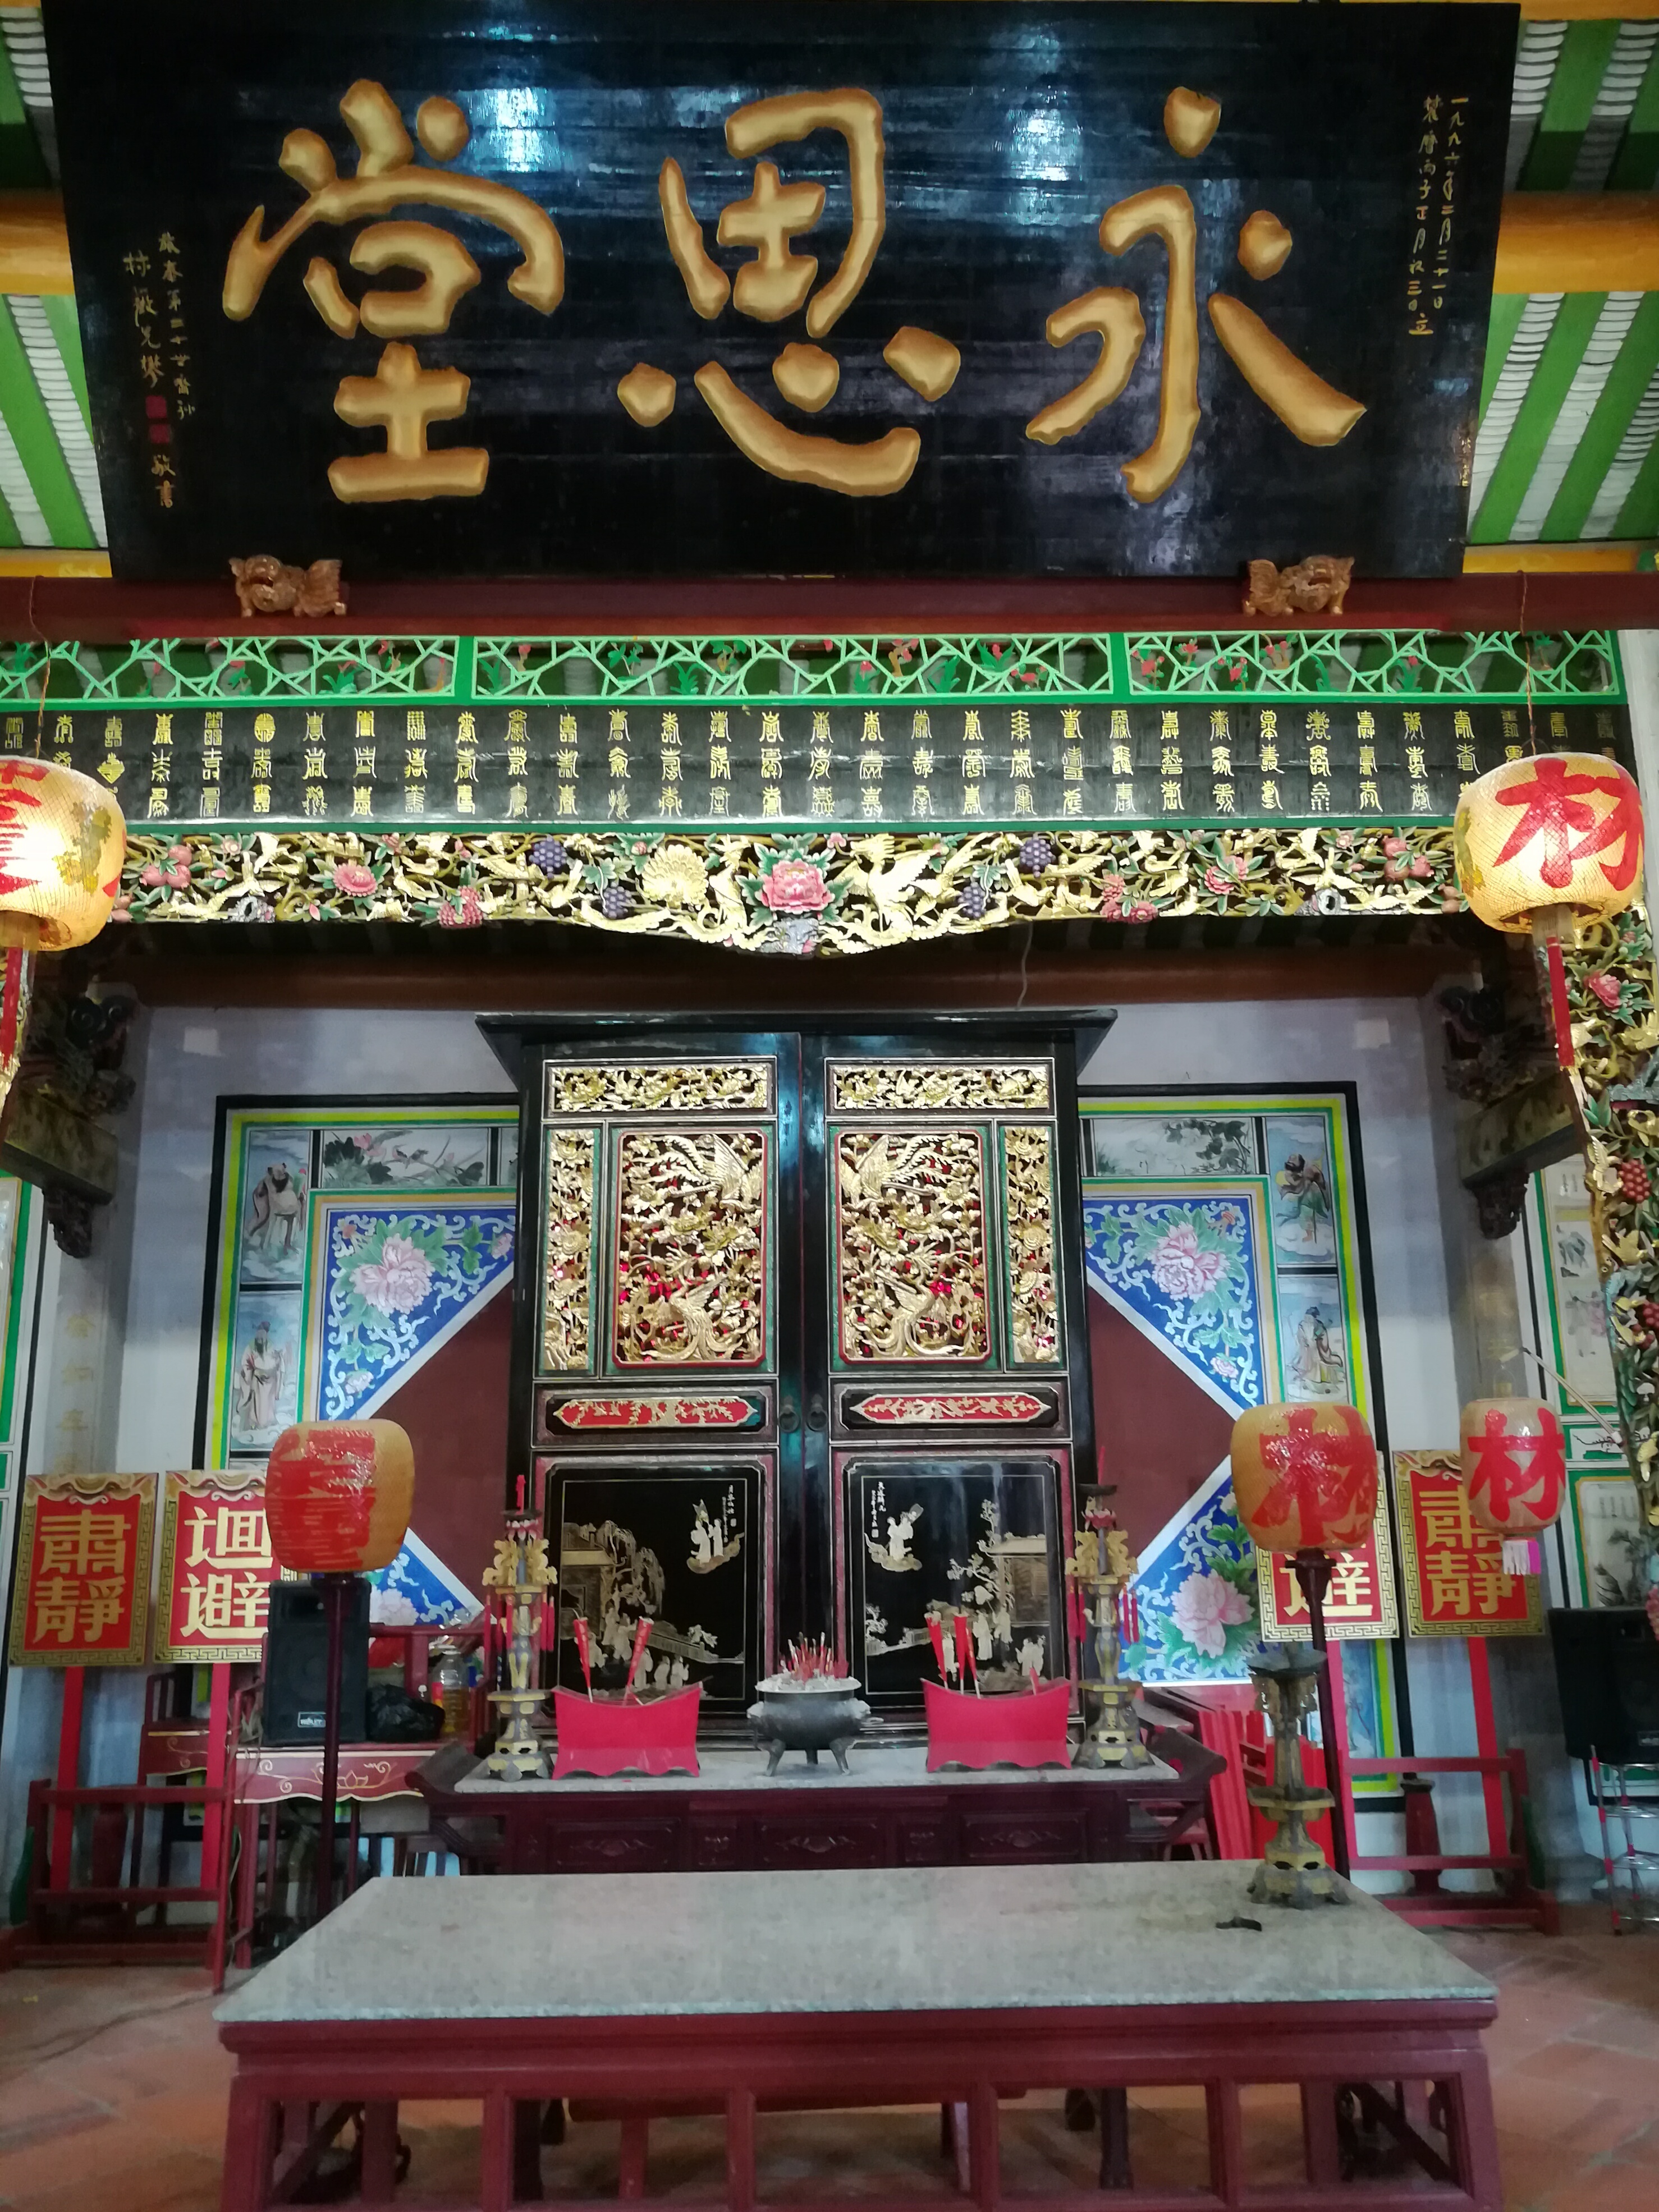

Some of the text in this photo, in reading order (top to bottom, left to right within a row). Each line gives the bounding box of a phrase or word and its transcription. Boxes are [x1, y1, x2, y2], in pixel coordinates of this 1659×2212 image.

[222, 79, 1367, 503] 永思堂
[33, 1509, 131, 1644] 肅靜
